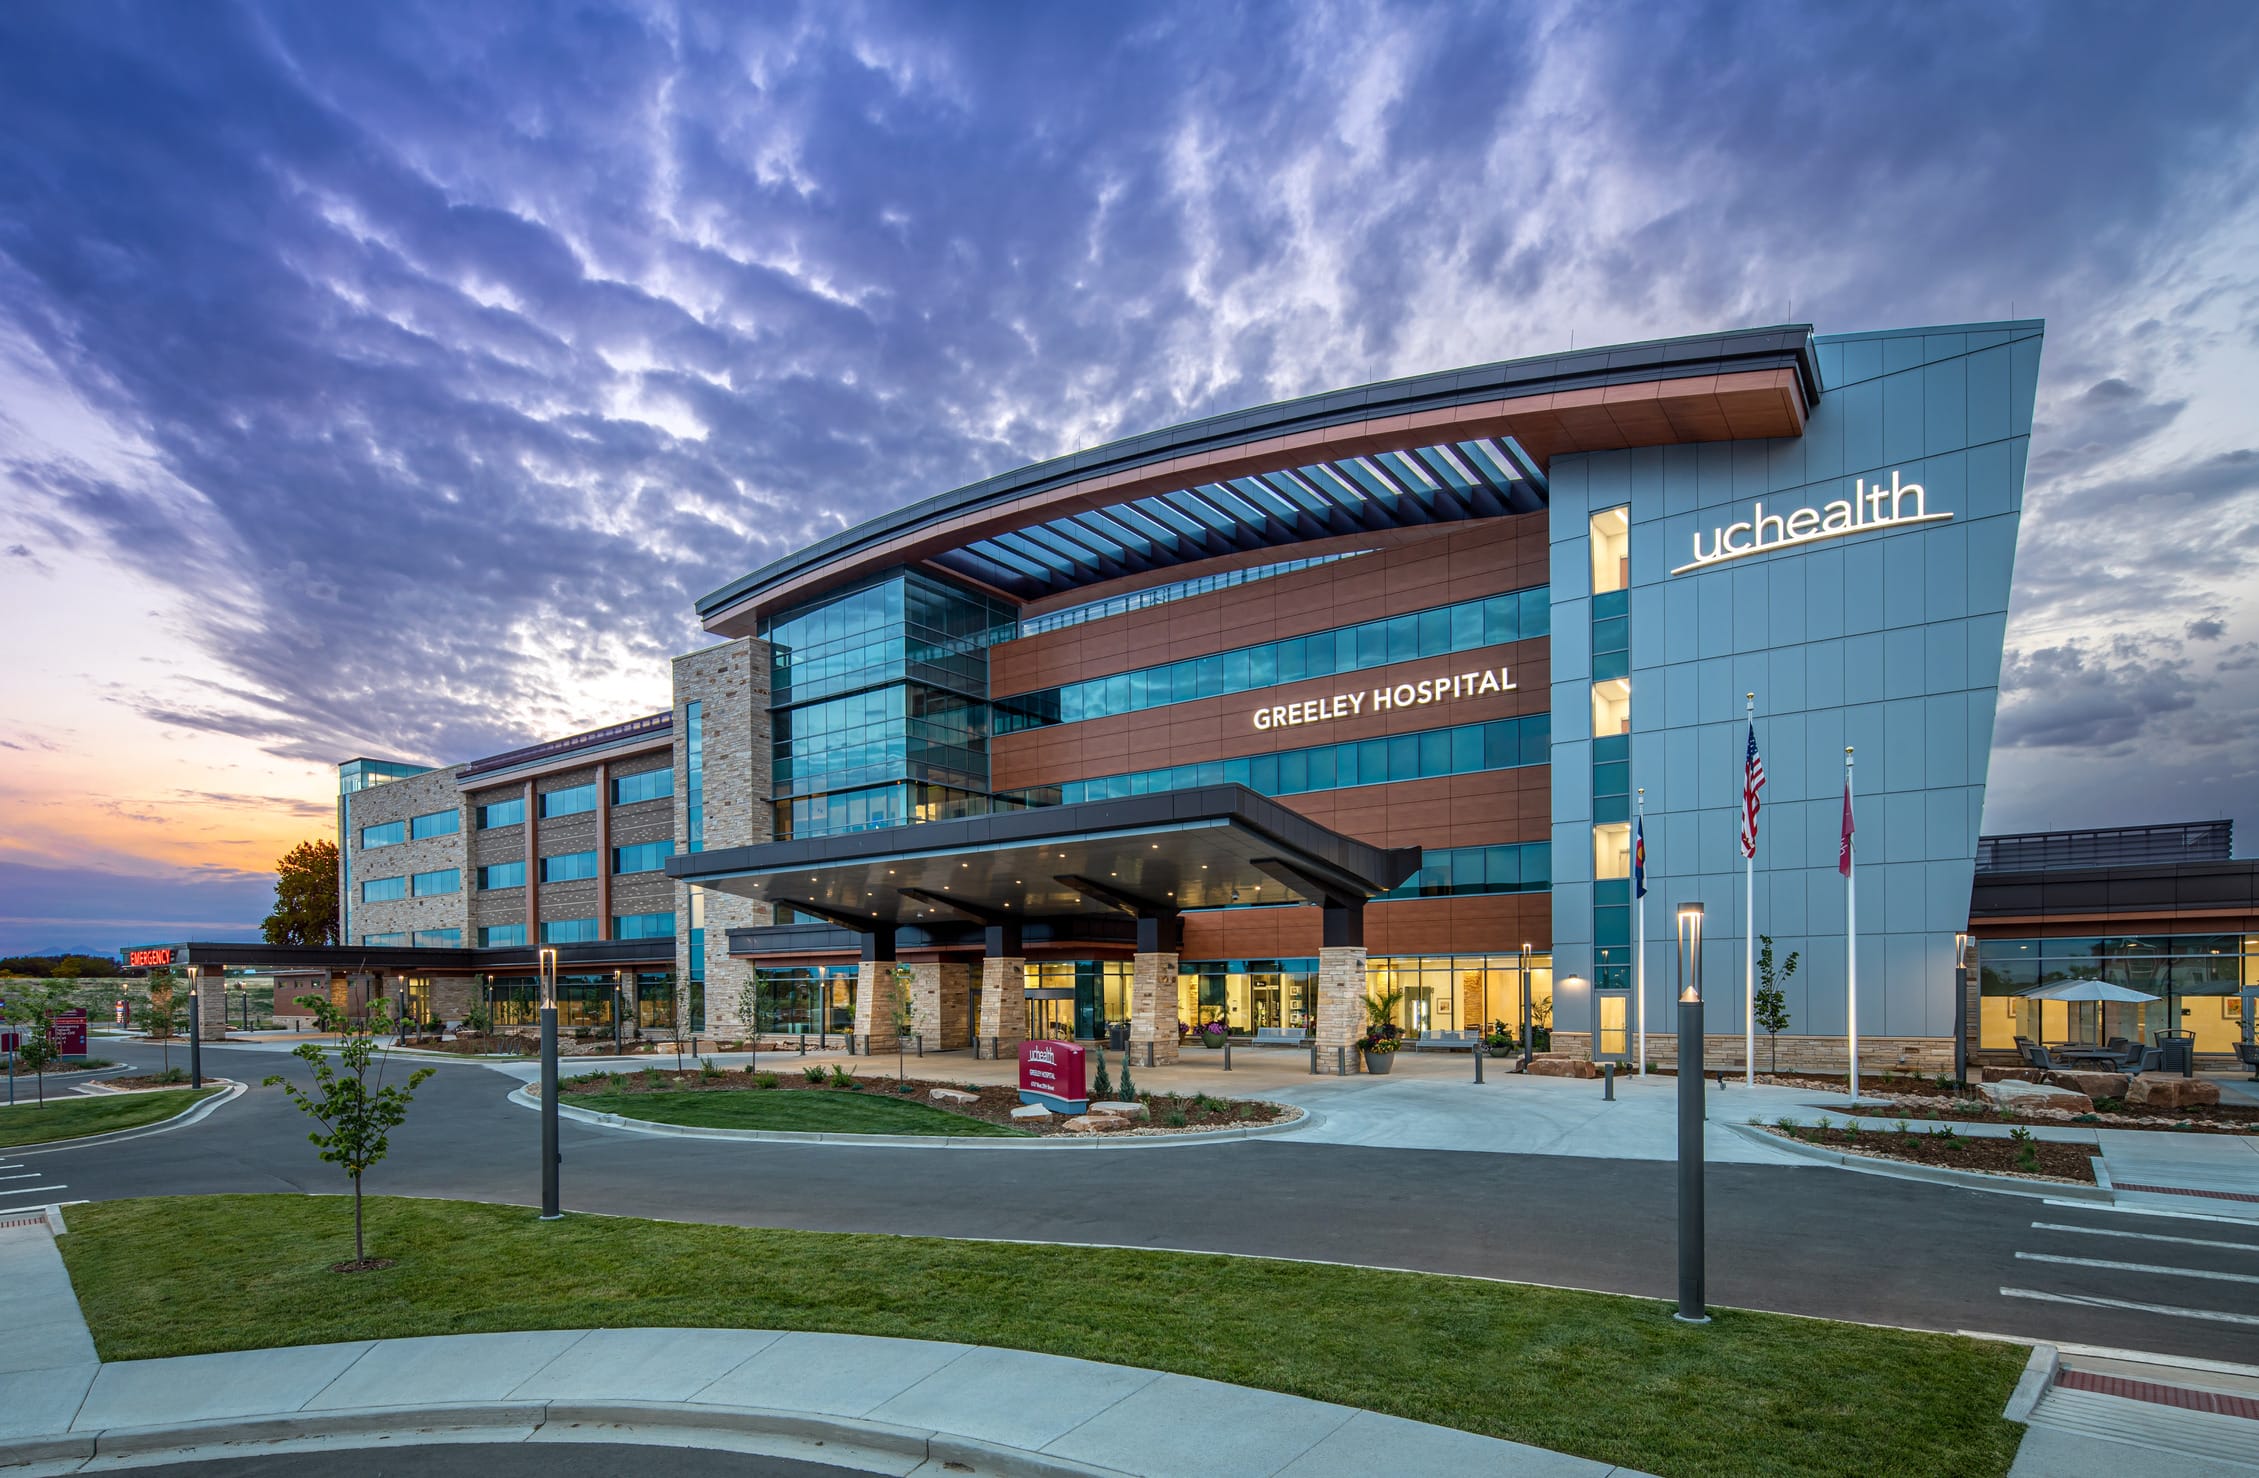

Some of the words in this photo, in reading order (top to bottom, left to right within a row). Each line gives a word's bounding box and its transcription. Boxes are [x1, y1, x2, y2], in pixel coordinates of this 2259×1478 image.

[1693, 470, 1925, 562] uchealth
[1253, 691, 1365, 730] GREELEY
[1373, 667, 1517, 711] HOSPITAL
[130, 949, 171, 966] EMERGENCY
